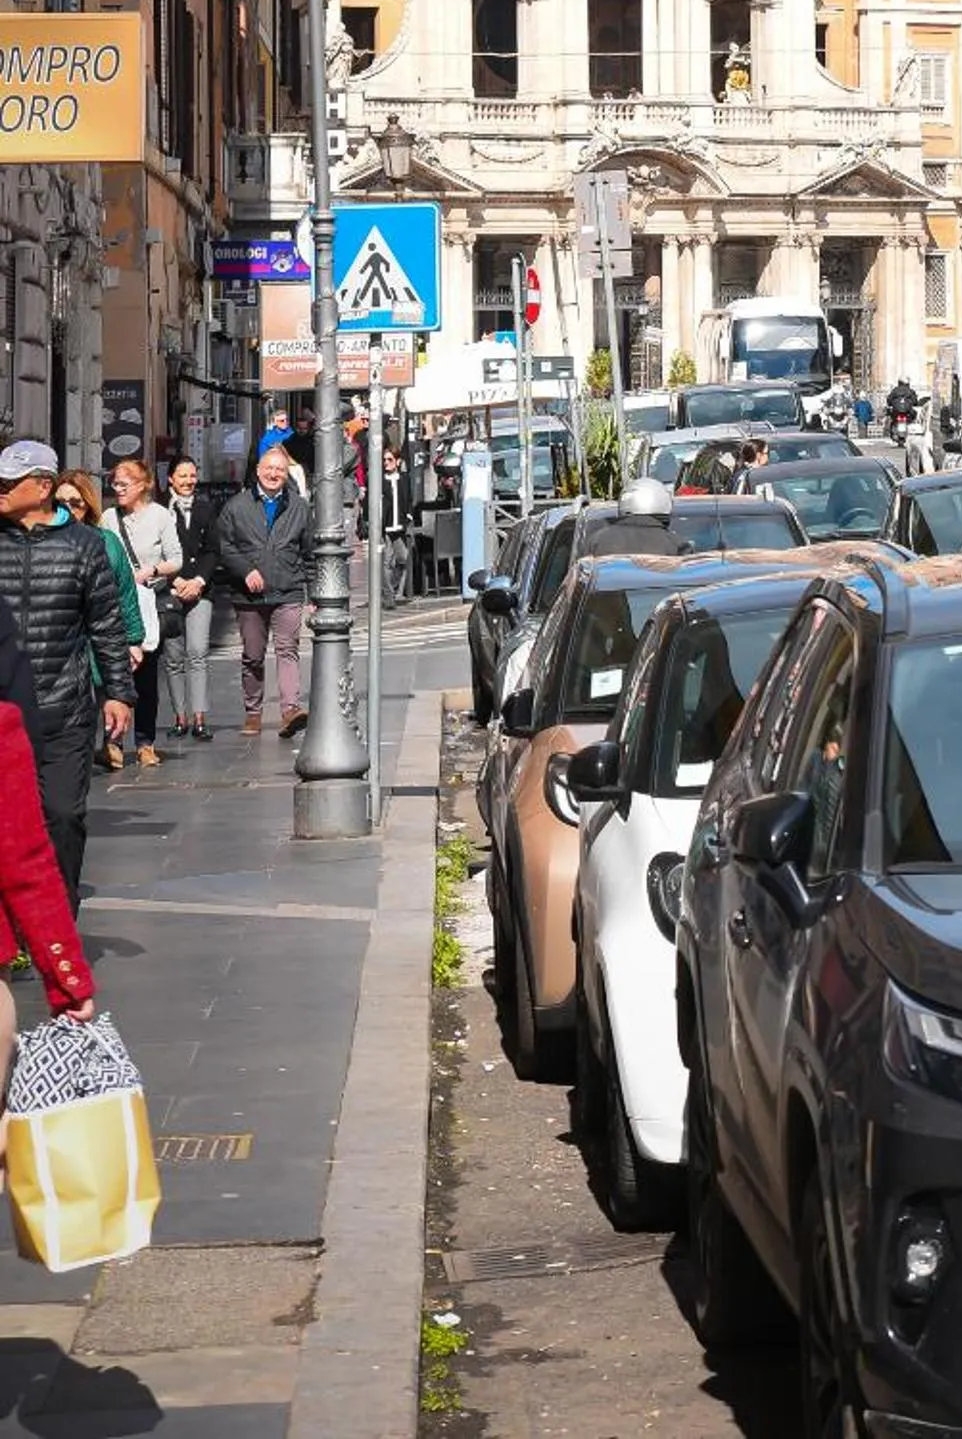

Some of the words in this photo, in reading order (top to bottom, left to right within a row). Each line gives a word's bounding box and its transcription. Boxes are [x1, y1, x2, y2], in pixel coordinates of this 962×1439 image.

[0, 44, 121, 83] MPRO
[0, 94, 79, 133] ORO
[214, 246, 268, 259] OROLOGI
